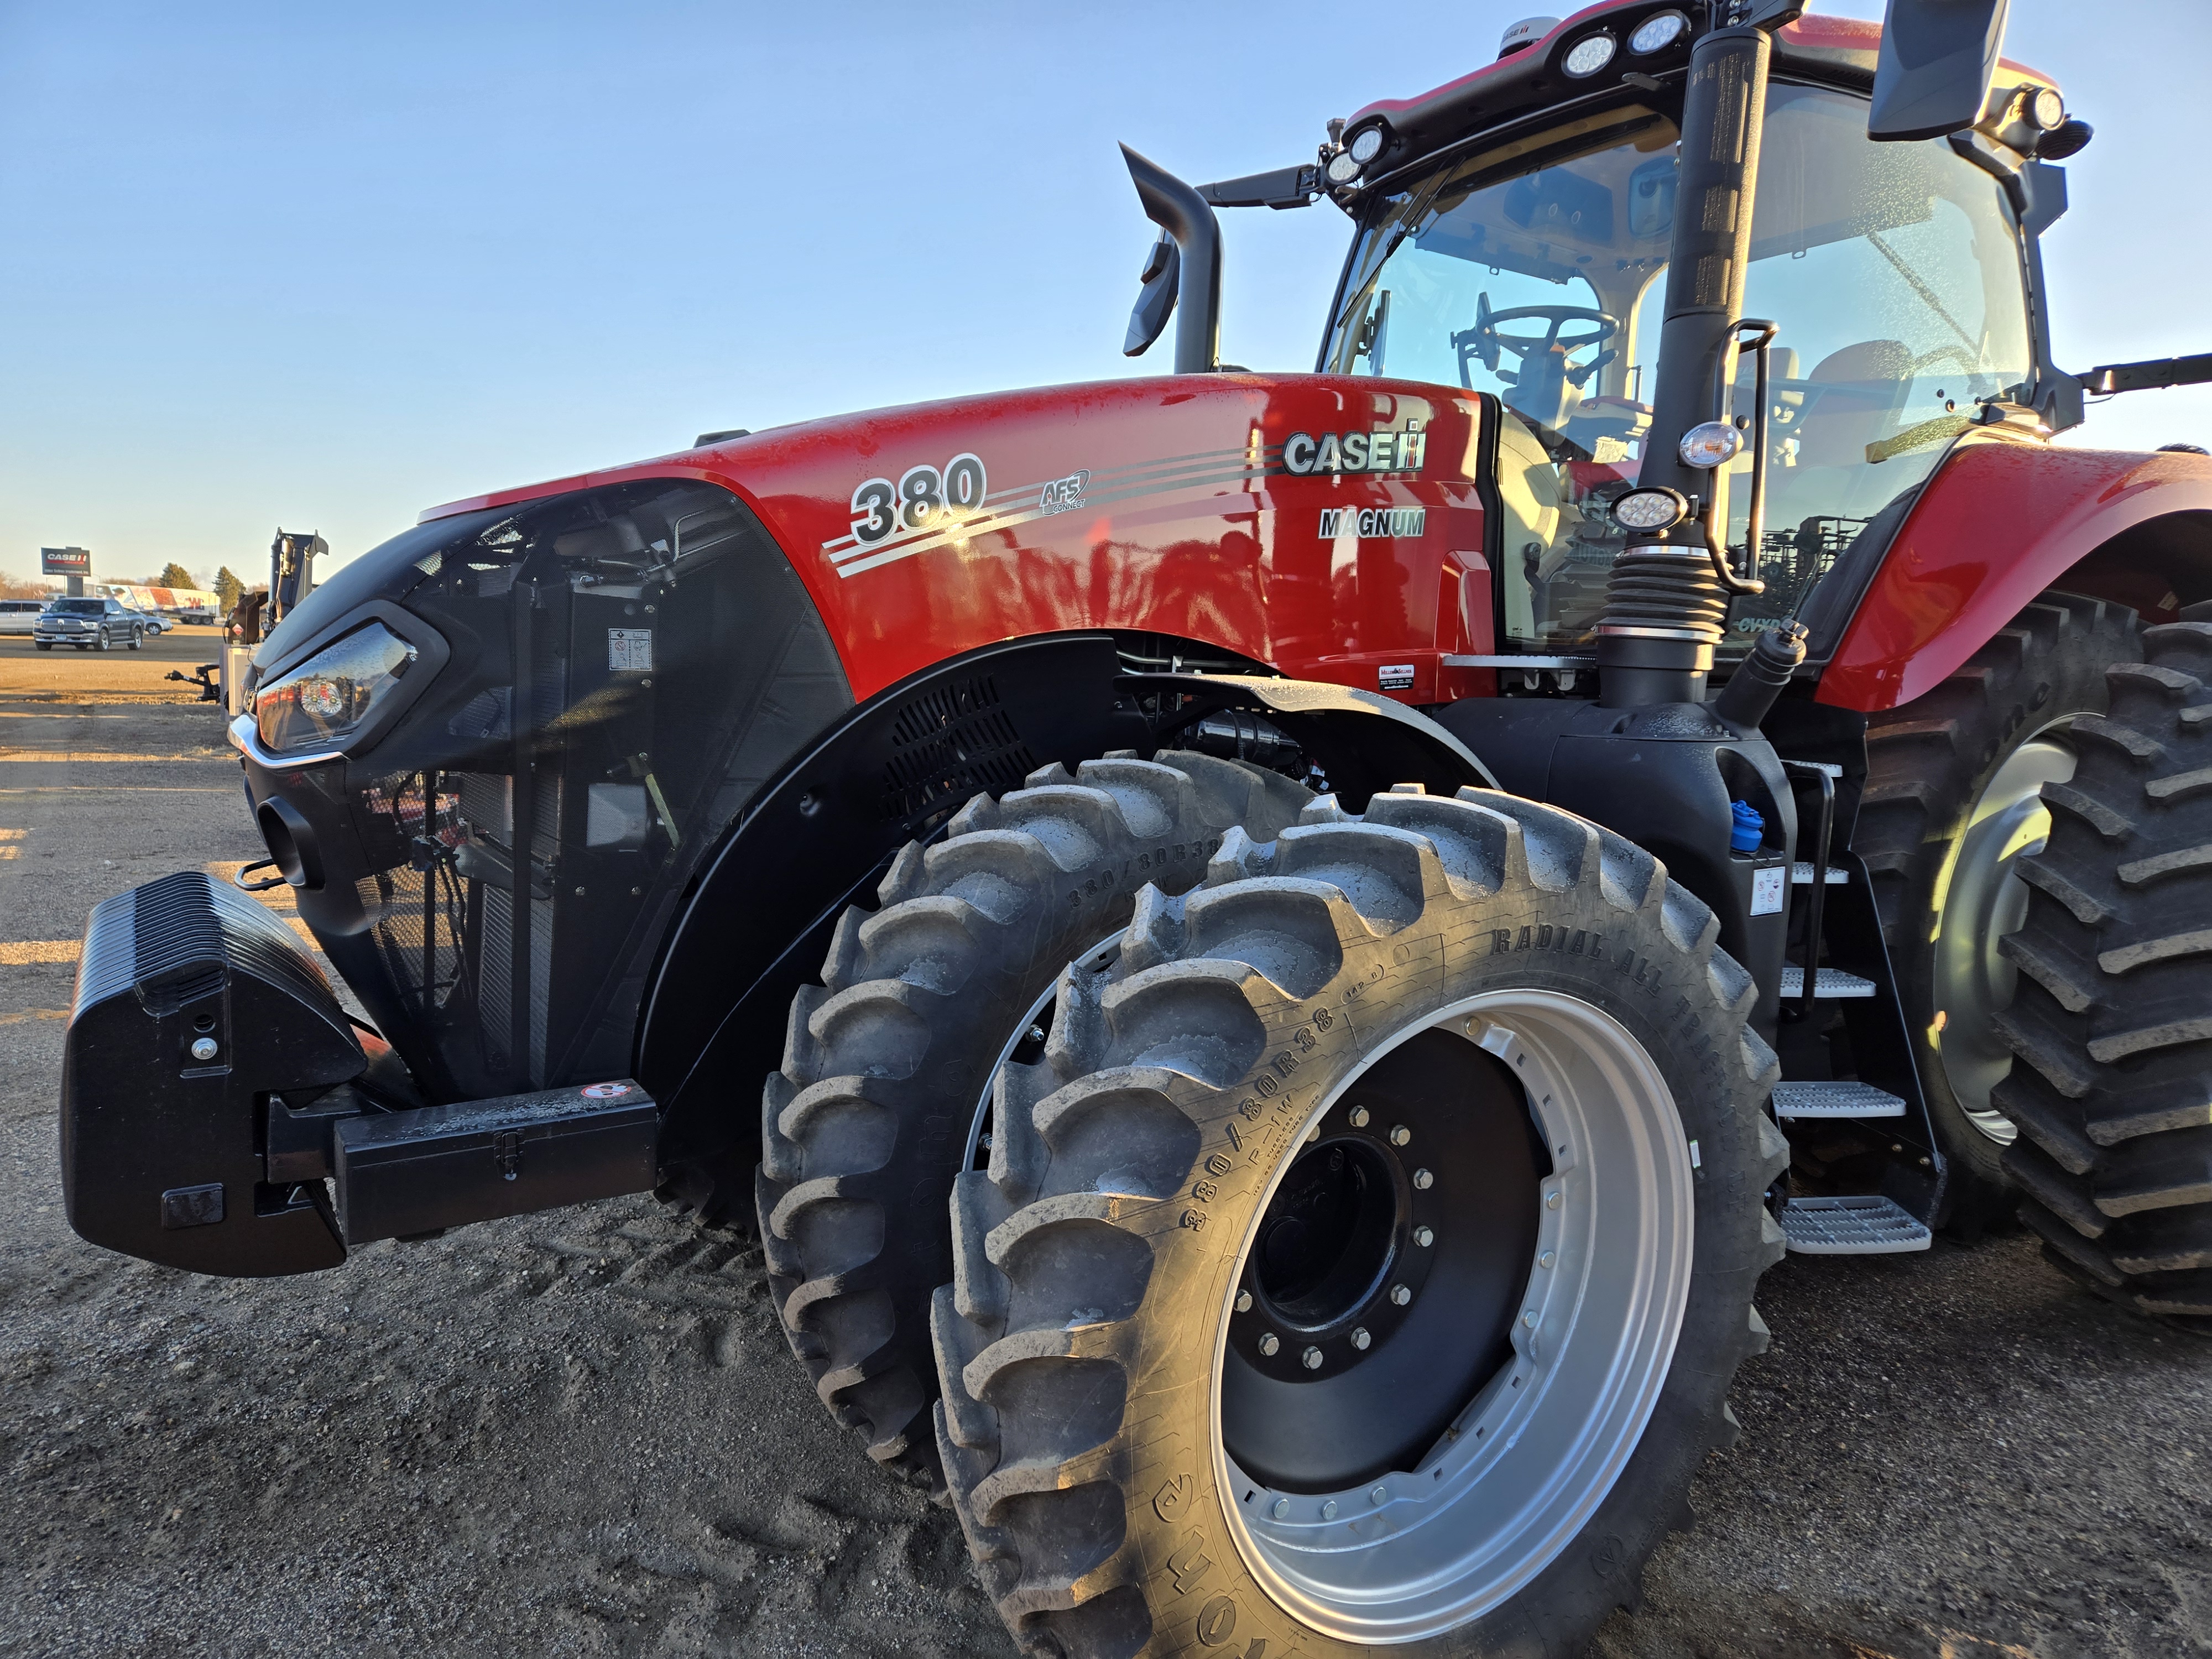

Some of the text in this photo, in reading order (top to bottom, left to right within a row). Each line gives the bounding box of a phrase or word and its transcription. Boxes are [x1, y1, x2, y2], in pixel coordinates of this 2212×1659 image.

[851, 453, 987, 546] 380
[1040, 476, 1080, 507] AFS
[1053, 499, 1085, 513] CONNECT
[1318, 508, 1426, 539] MAGNUM
[1067, 838, 1219, 910] 380/80R38
[1493, 922, 1604, 960] RADIAL
[1615, 947, 1663, 997] ALL
[1184, 1006, 1335, 1232] 380/80R38
[1288, 1115, 1303, 1134] TUBE
[1305, 1094, 1321, 1112] TYPE
[1267, 1117, 1294, 1158] TUBELESS
